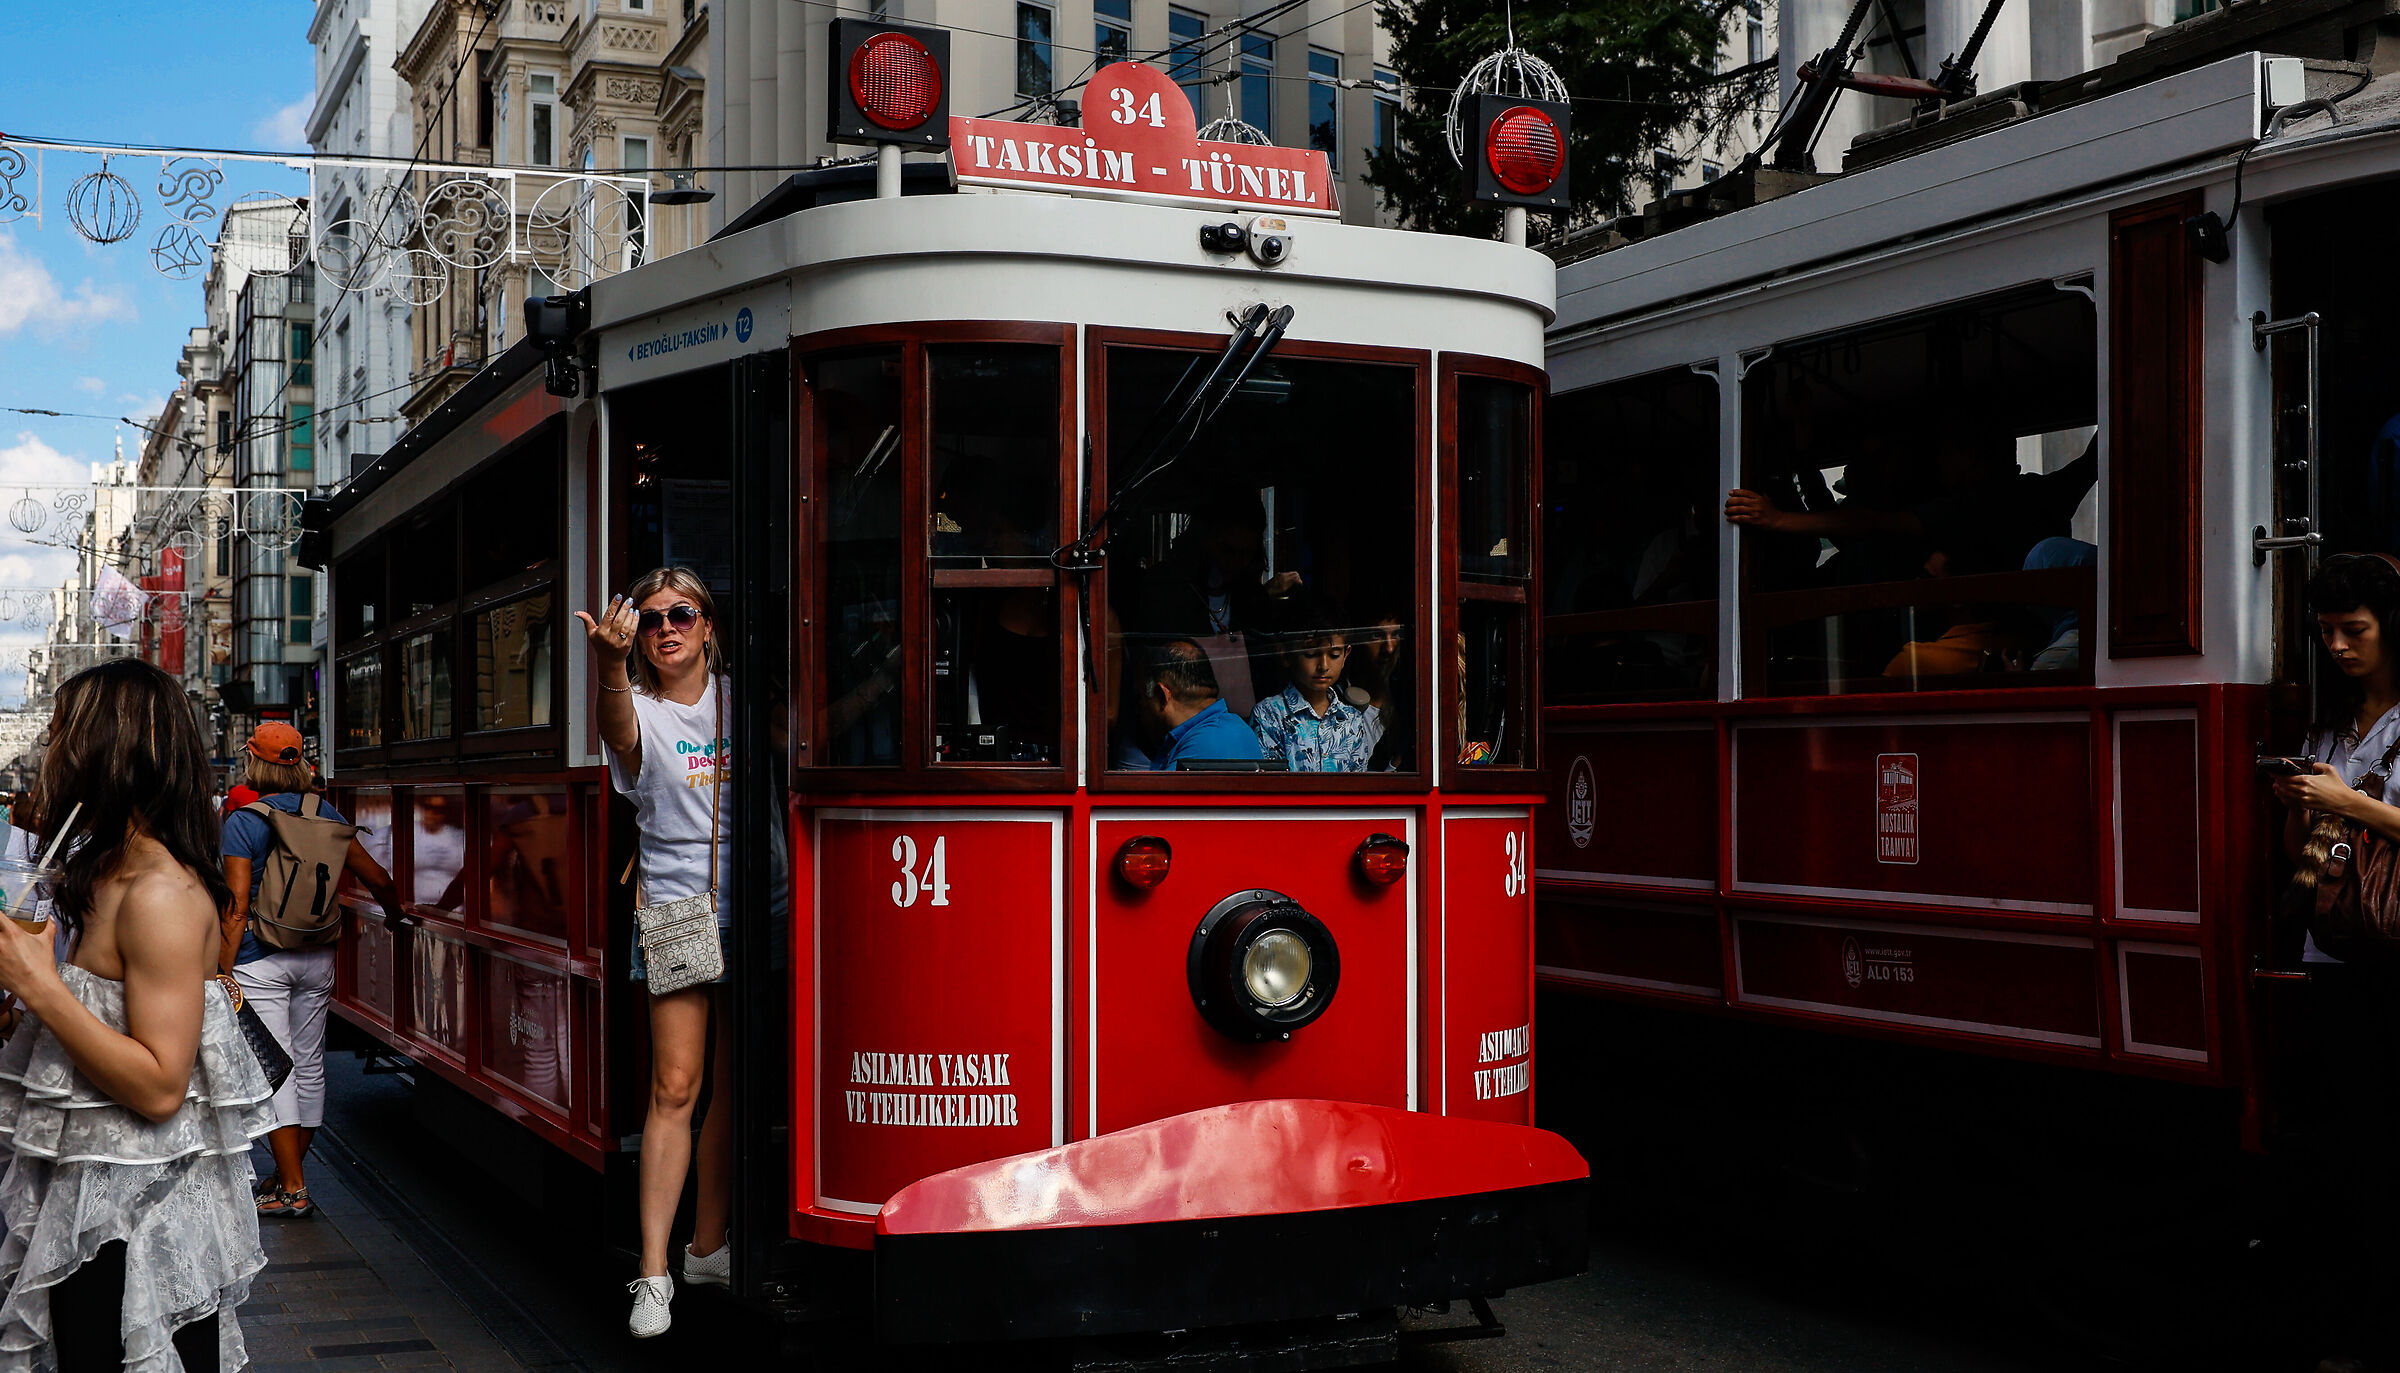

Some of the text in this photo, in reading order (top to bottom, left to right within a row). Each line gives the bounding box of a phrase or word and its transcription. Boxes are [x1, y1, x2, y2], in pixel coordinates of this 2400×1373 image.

[1110, 87, 1166, 128] 34
[967, 135, 1136, 184] TAKSİM
[1182, 151, 1316, 203] TÜNEL
[637, 322, 719, 360] BEYOĞLU-TAKSİM
[738, 315, 751, 335] T2
[1505, 830, 1526, 898] 34
[1880, 837, 1915, 857] TRAMVAY
[891, 834, 951, 908] 34
[1867, 964, 1915, 983] ALO 153
[850, 1051, 1010, 1087] ASILMAK YASAK
[1473, 1069, 1491, 1101] VE
[845, 1090, 1019, 1127] VE TEHLIKELIDIR
